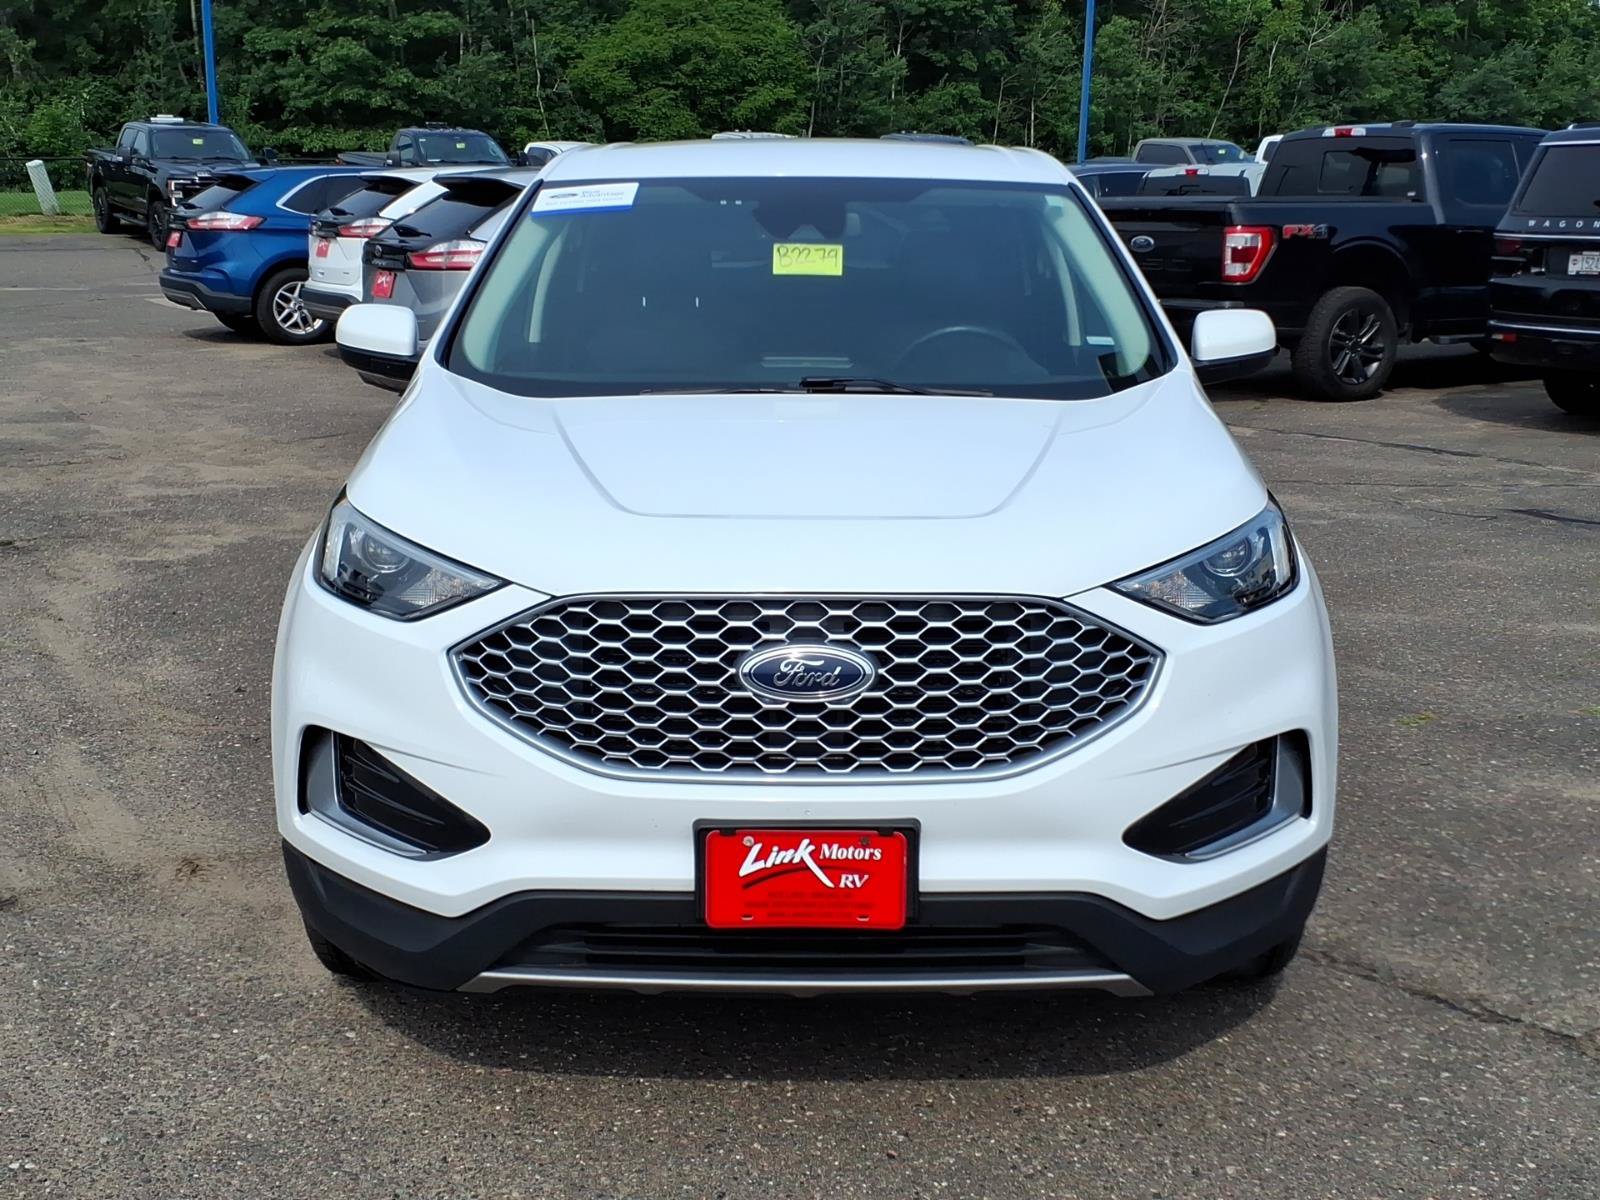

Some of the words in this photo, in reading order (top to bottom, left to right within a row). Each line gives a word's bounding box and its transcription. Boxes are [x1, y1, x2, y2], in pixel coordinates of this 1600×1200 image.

[773, 659, 842, 687] Ford
[738, 838, 835, 888] Link
[819, 843, 882, 860] Motors
[839, 874, 869, 889] RV
